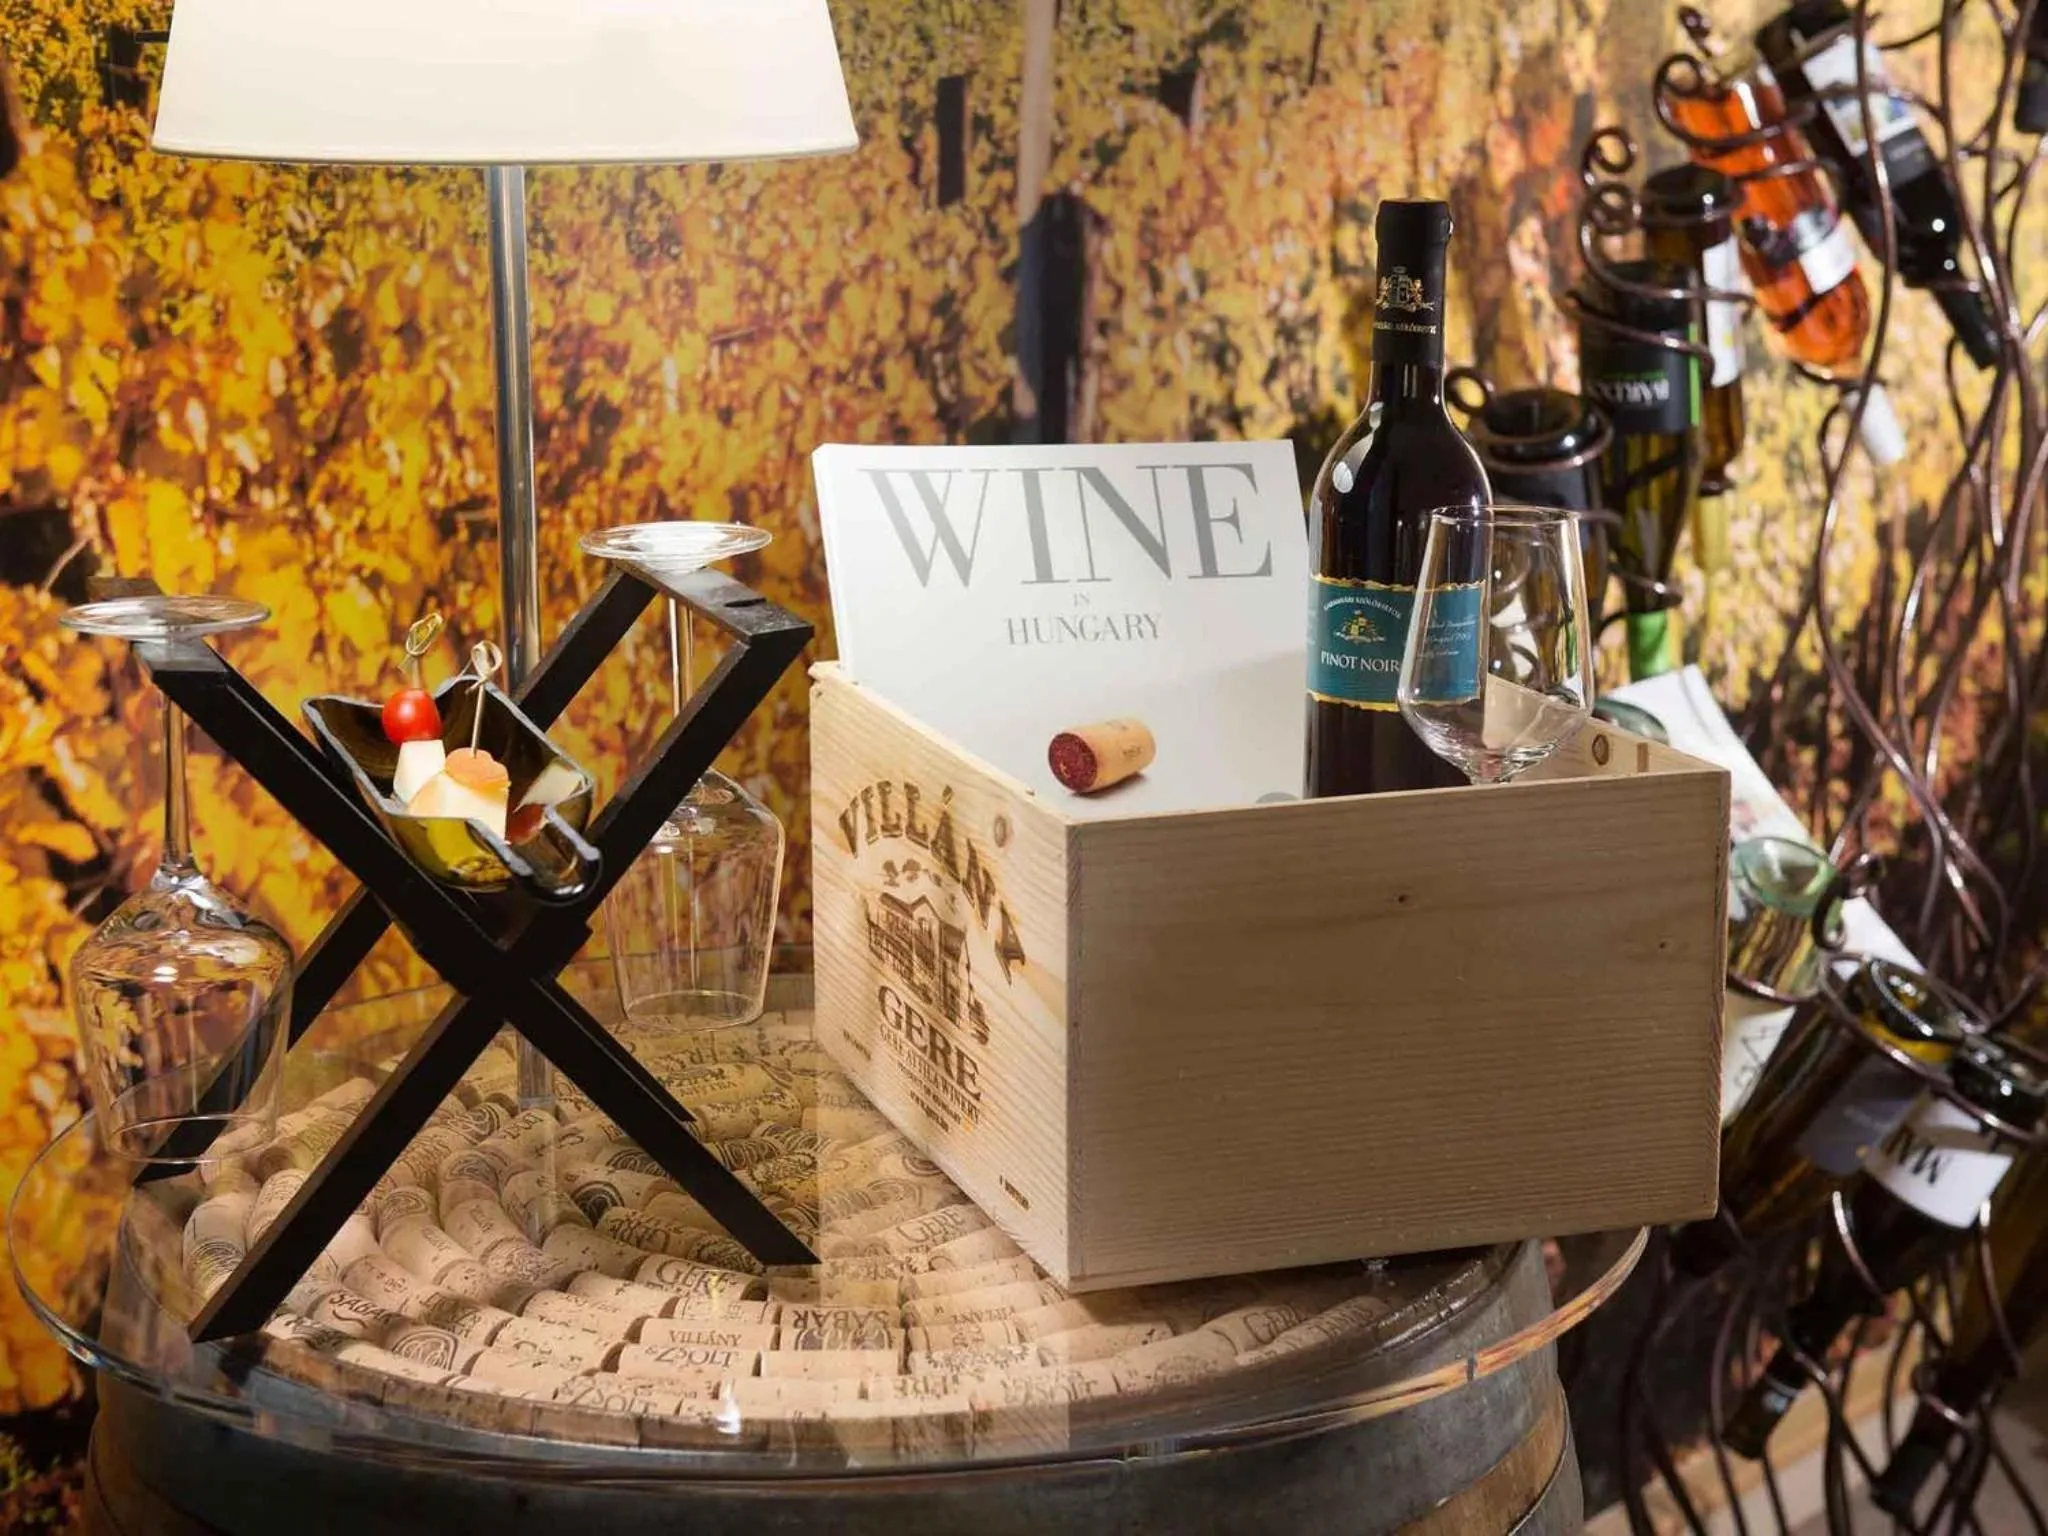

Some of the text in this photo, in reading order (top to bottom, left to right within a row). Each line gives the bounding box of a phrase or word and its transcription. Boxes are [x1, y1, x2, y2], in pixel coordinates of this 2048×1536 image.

[858, 462, 1273, 588] WINE
[1073, 592, 1091, 607] IN
[1006, 613, 1162, 646] HUNGARY
[1321, 650, 1400, 673] PINOT NOIR
[878, 985, 982, 1101] GERE
[940, 1075, 981, 1125] WINERY
[896, 1209, 965, 1244] GERE
[792, 1309, 890, 1330] SABAR
[668, 1329, 743, 1347] VILLÁNY
